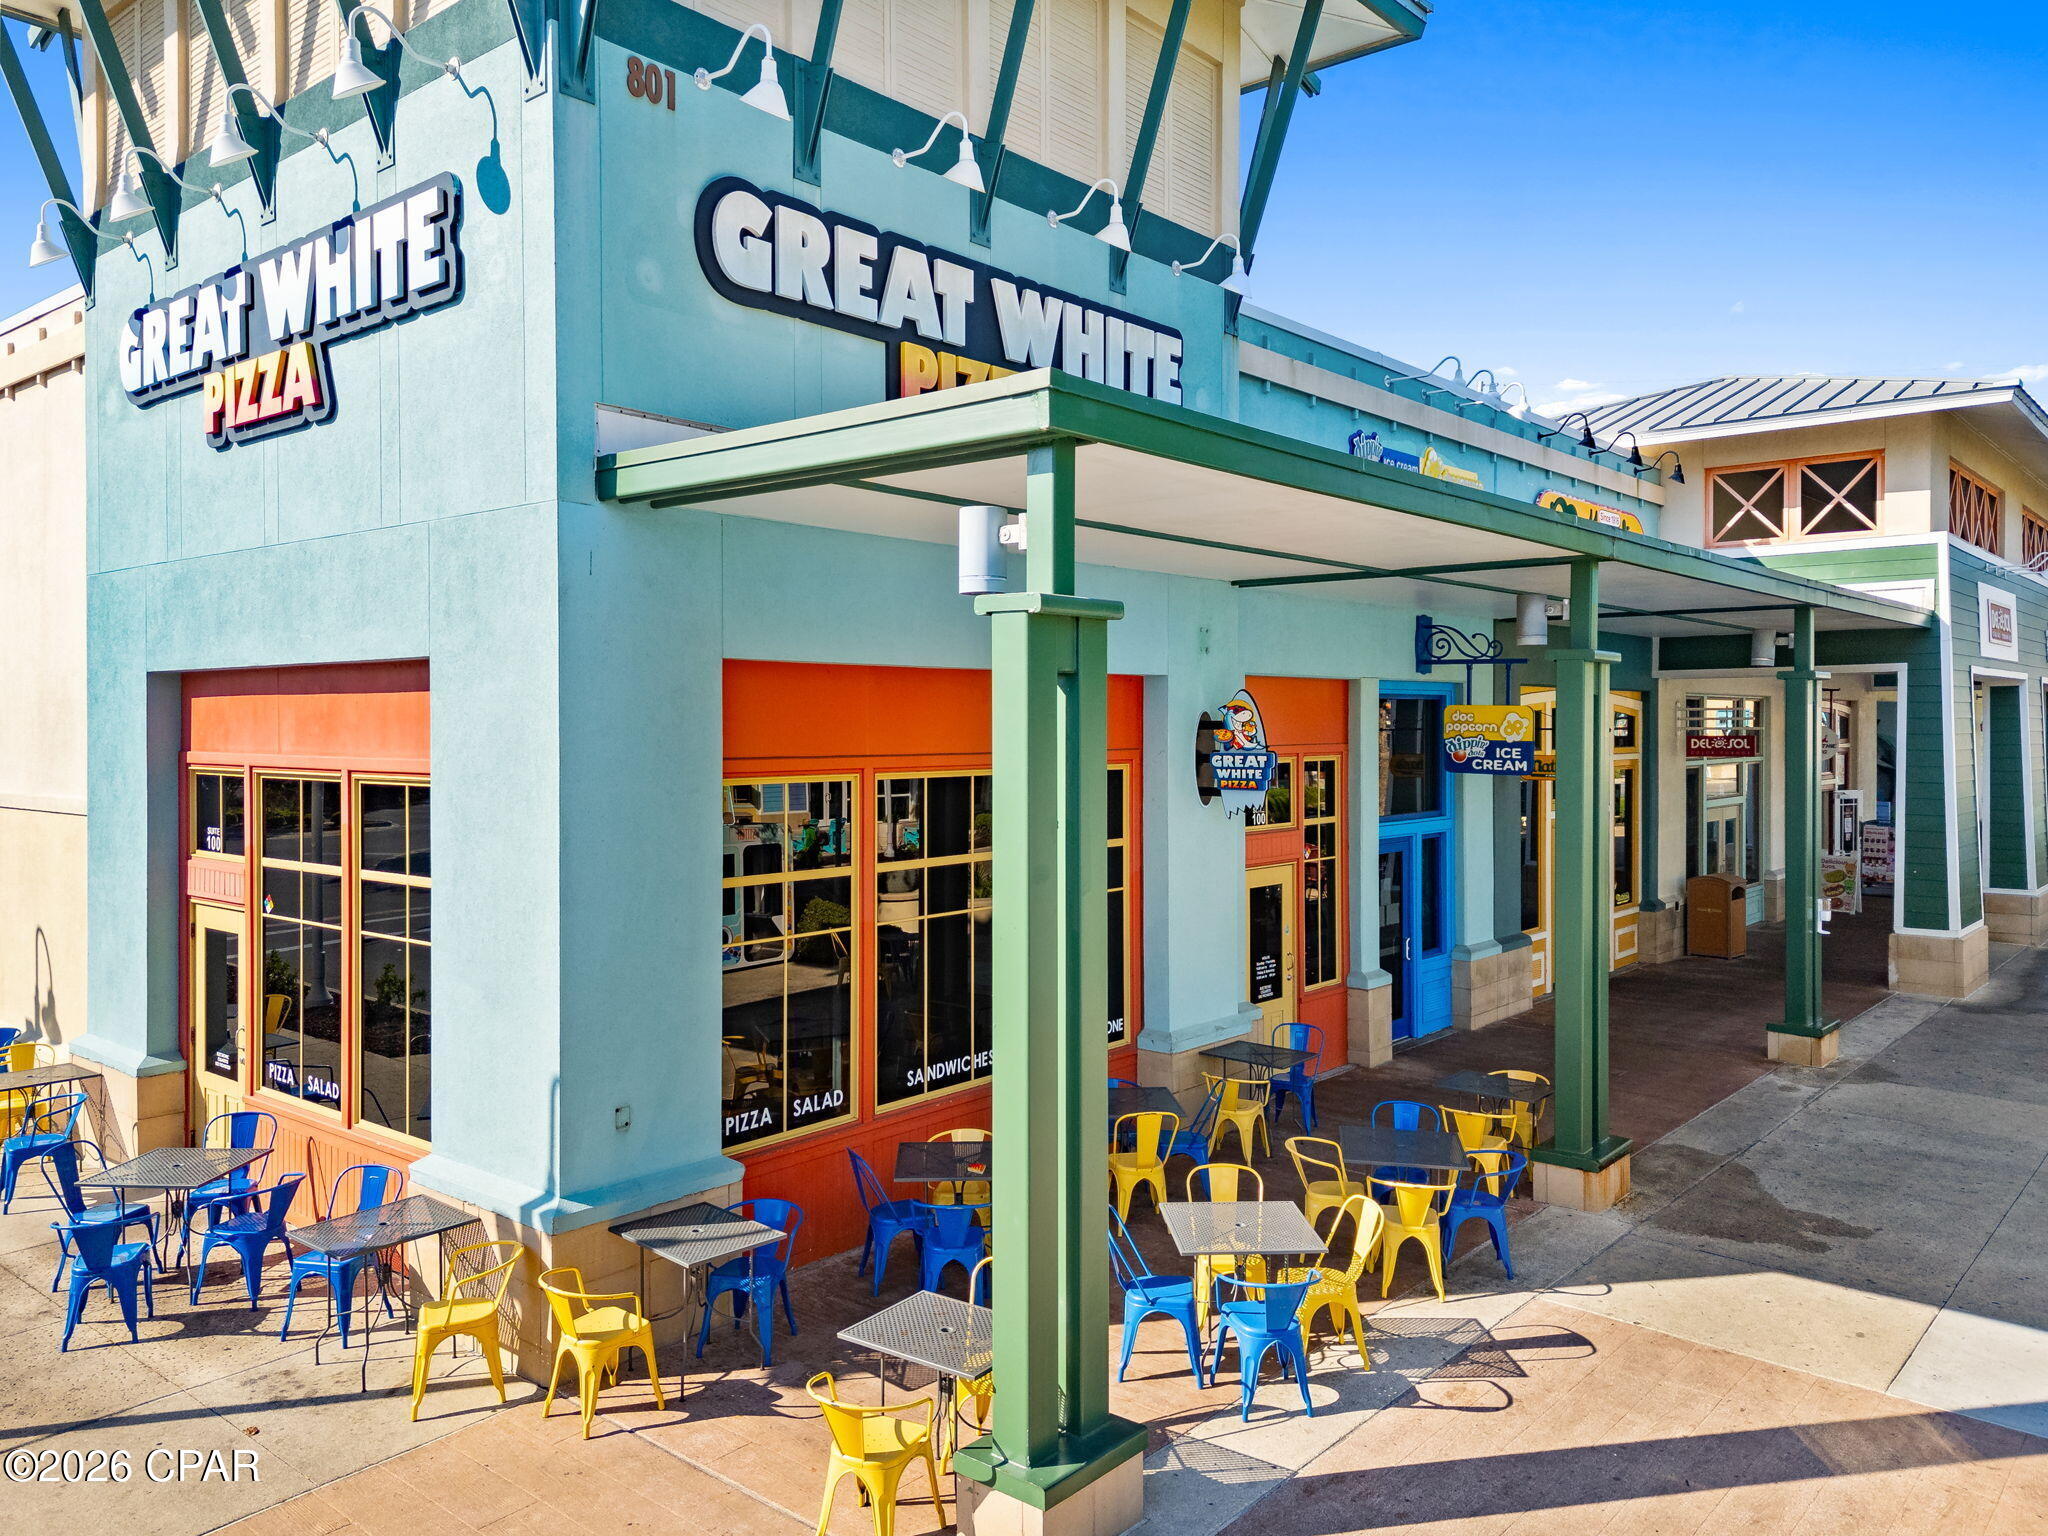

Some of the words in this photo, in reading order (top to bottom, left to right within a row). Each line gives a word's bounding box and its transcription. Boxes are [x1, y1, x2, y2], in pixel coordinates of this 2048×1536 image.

[627, 56, 675, 111] 801
[119, 269, 254, 393] GREAT
[258, 185, 450, 342] WHITE
[711, 189, 974, 347] GREAT
[990, 276, 1183, 406] WHITE
[900, 340, 1022, 399] PIZ
[202, 340, 323, 434] PIZZA
[1452, 711, 1475, 721] doc
[1446, 722, 1498, 733] popcorn
[1690, 738, 1712, 749] DEL
[1727, 738, 1751, 749] SOL
[1211, 754, 1268, 769] GREAT
[1495, 747, 1522, 759] ICE
[1216, 768, 1263, 780] WHITE
[1472, 759, 1528, 772] CREAM
[1220, 779, 1258, 790] PIZZA
[1252, 812, 1266, 826] 100
[207, 835, 220, 852] 100
[1107, 1017, 1124, 1034] ONE
[906, 1050, 993, 1088] SANDWICHES
[268, 1062, 295, 1086] PIZZA
[307, 1075, 340, 1100] SALAD
[725, 1106, 773, 1136] PIZZA
[793, 1088, 844, 1118] SALAD
